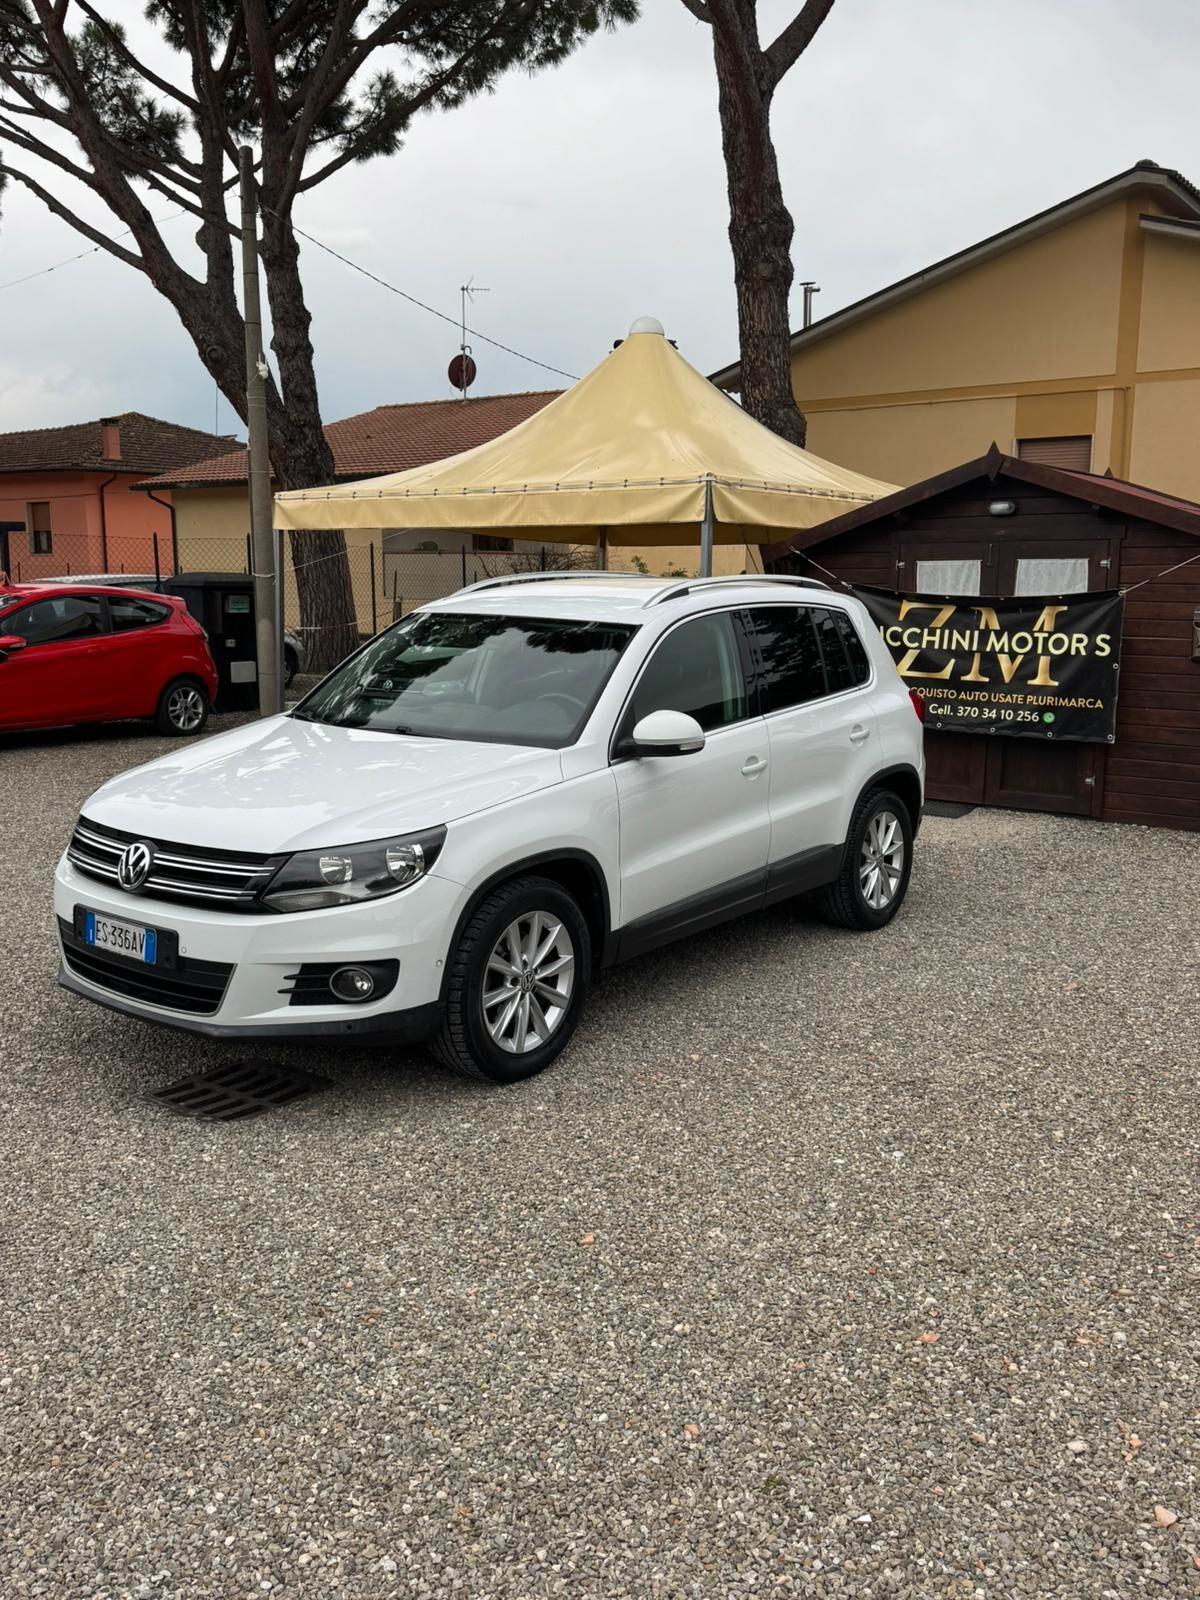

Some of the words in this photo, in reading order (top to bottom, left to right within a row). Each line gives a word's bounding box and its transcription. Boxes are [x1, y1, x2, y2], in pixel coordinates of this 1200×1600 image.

[958, 691, 989, 702] AUTO
[991, 692, 1025, 704] USATE
[1026, 695, 1104, 709] PLURIMARCA
[929, 703, 954, 716] Cell.
[957, 706, 979, 718] 370
[982, 708, 997, 719] 34
[1000, 709, 1014, 720] 10
[1016, 711, 1040, 722] 256
